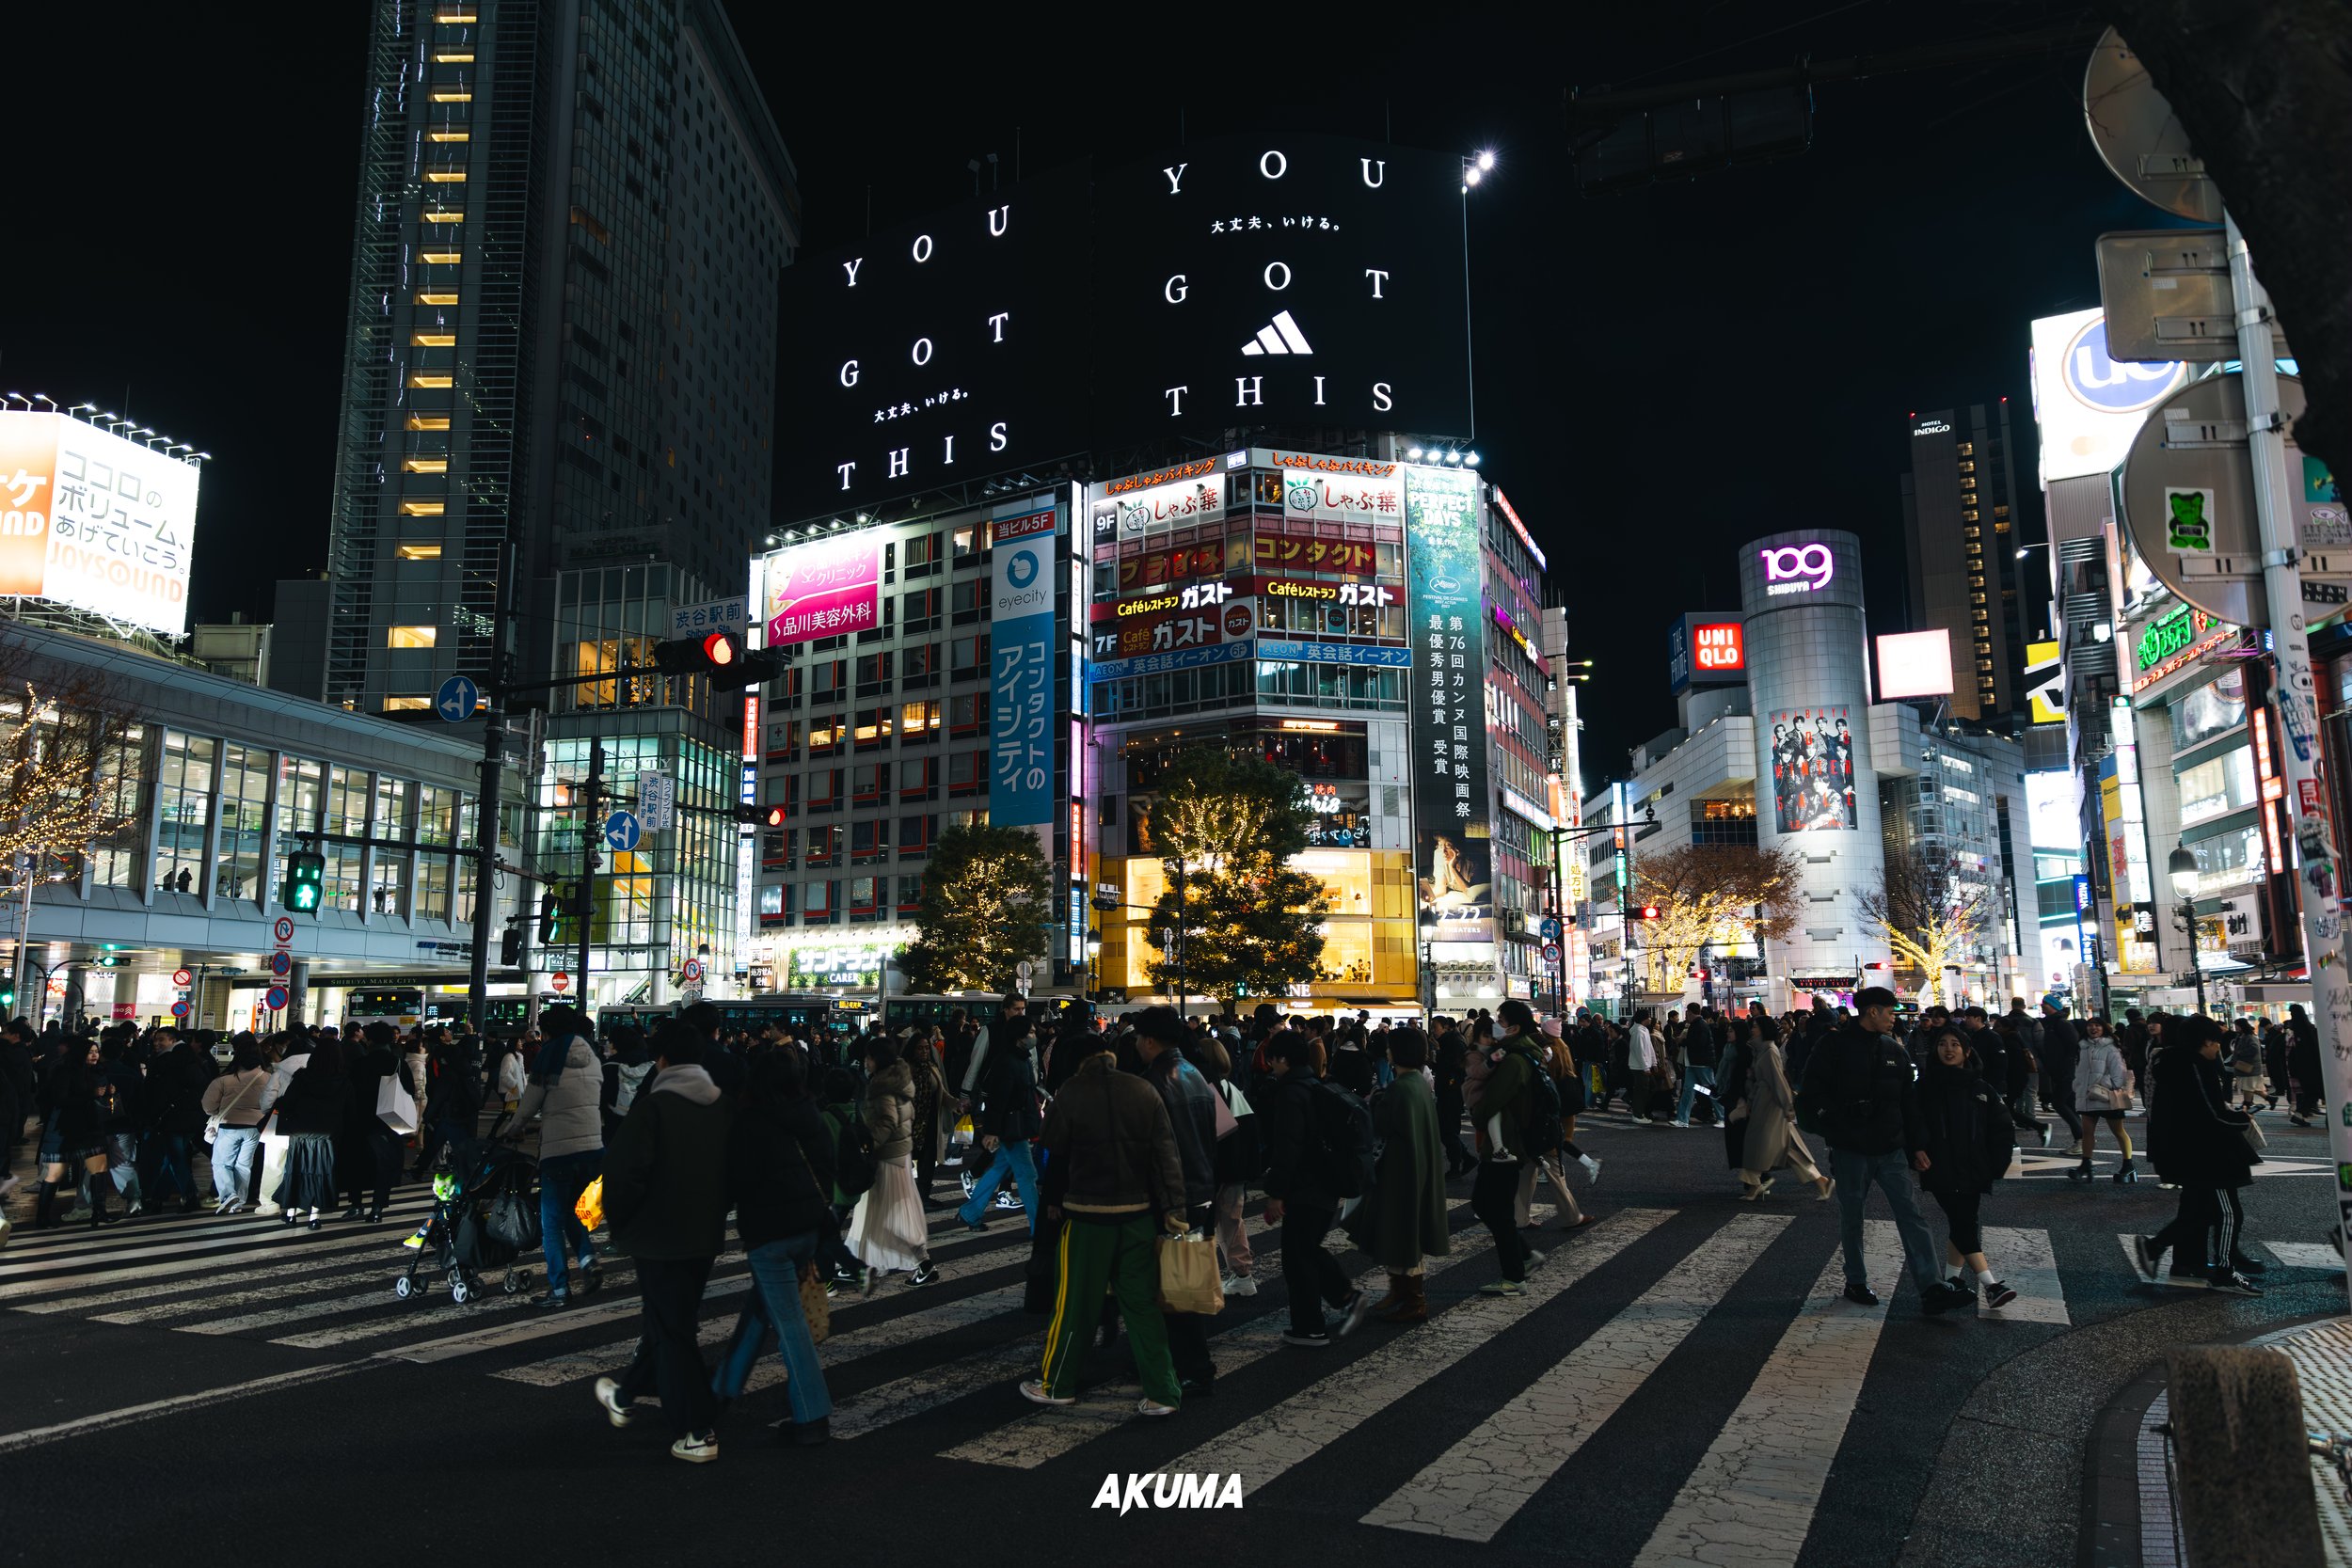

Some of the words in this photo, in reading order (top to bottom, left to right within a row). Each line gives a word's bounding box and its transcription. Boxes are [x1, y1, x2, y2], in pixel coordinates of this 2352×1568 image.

[1163, 150, 1386, 195] YOU
[1211, 215, 1341, 235] 大丈夫、いける。
[842, 204, 1010, 288] YOU
[1164, 261, 1390, 305] GOT
[839, 311, 1009, 388] GOT
[873, 388, 970, 423] 大丈夫、いける。
[1164, 375, 1394, 419] THIS
[1914, 424, 1950, 436] INDIGO
[836, 421, 1009, 491] THIS
[1273, 451, 1397, 478] しゃぶしゃぶバイキング
[61, 450, 163, 509] ココロの
[1105, 457, 1216, 496] しゃぶしゃぶバイキング
[1154, 487, 1218, 520] しゃぶ葉
[1325, 484, 1397, 514] しゃぶ葉
[1410, 491, 1473, 513] PERFECT
[58, 484, 185, 550] ボリューム、
[998, 515, 1049, 537] 当ビル5F
[1096, 514, 1116, 531] 9F
[1422, 509, 1461, 528] DAYS
[56, 515, 185, 575] あげていこう。
[1256, 537, 1372, 567] コンタクト
[817, 562, 866, 587] クリニック
[1120, 543, 1224, 584] プライス
[1761, 543, 1834, 590] 109
[998, 588, 1047, 610] eyecity
[1181, 581, 1233, 610] ガスト
[1339, 583, 1394, 608] ガスト
[1767, 580, 1810, 596] SHIBUYA
[675, 602, 742, 629] 渋谷駅前
[783, 601, 872, 636] 品川美容外科
[1228, 618, 1249, 628] ガスト
[1095, 634, 1118, 654] 7F
[1123, 628, 1150, 644] Café
[1152, 616, 1216, 652] ガスト
[1698, 628, 1734, 646] UNI
[1094, 662, 1124, 677] AEON
[1133, 646, 1226, 673] 英会話イーオン
[1231, 644, 1247, 657] 6F
[1263, 642, 1298, 657] AEON
[1307, 644, 1408, 664] 英会話イーオン
[1699, 647, 1739, 668] QLO
[1428, 614, 1447, 724] 最優秀男優賞
[997, 645, 1024, 793] アイシティ
[1026, 641, 1046, 791] コンタクトの
[1449, 615, 1471, 817] 第76回カンヌ国際映画祭
[1772, 707, 1847, 724] SHIBUYA
[1773, 730, 1850, 750] 109
[1433, 739, 1448, 774] 受賞
[1774, 759, 1851, 780] WINTER
[646, 776, 660, 828] 渋谷駅前
[661, 780, 673, 828] スクランブル式
[1314, 783, 1337, 796] 焼肉
[1776, 791, 1854, 812] SALE
